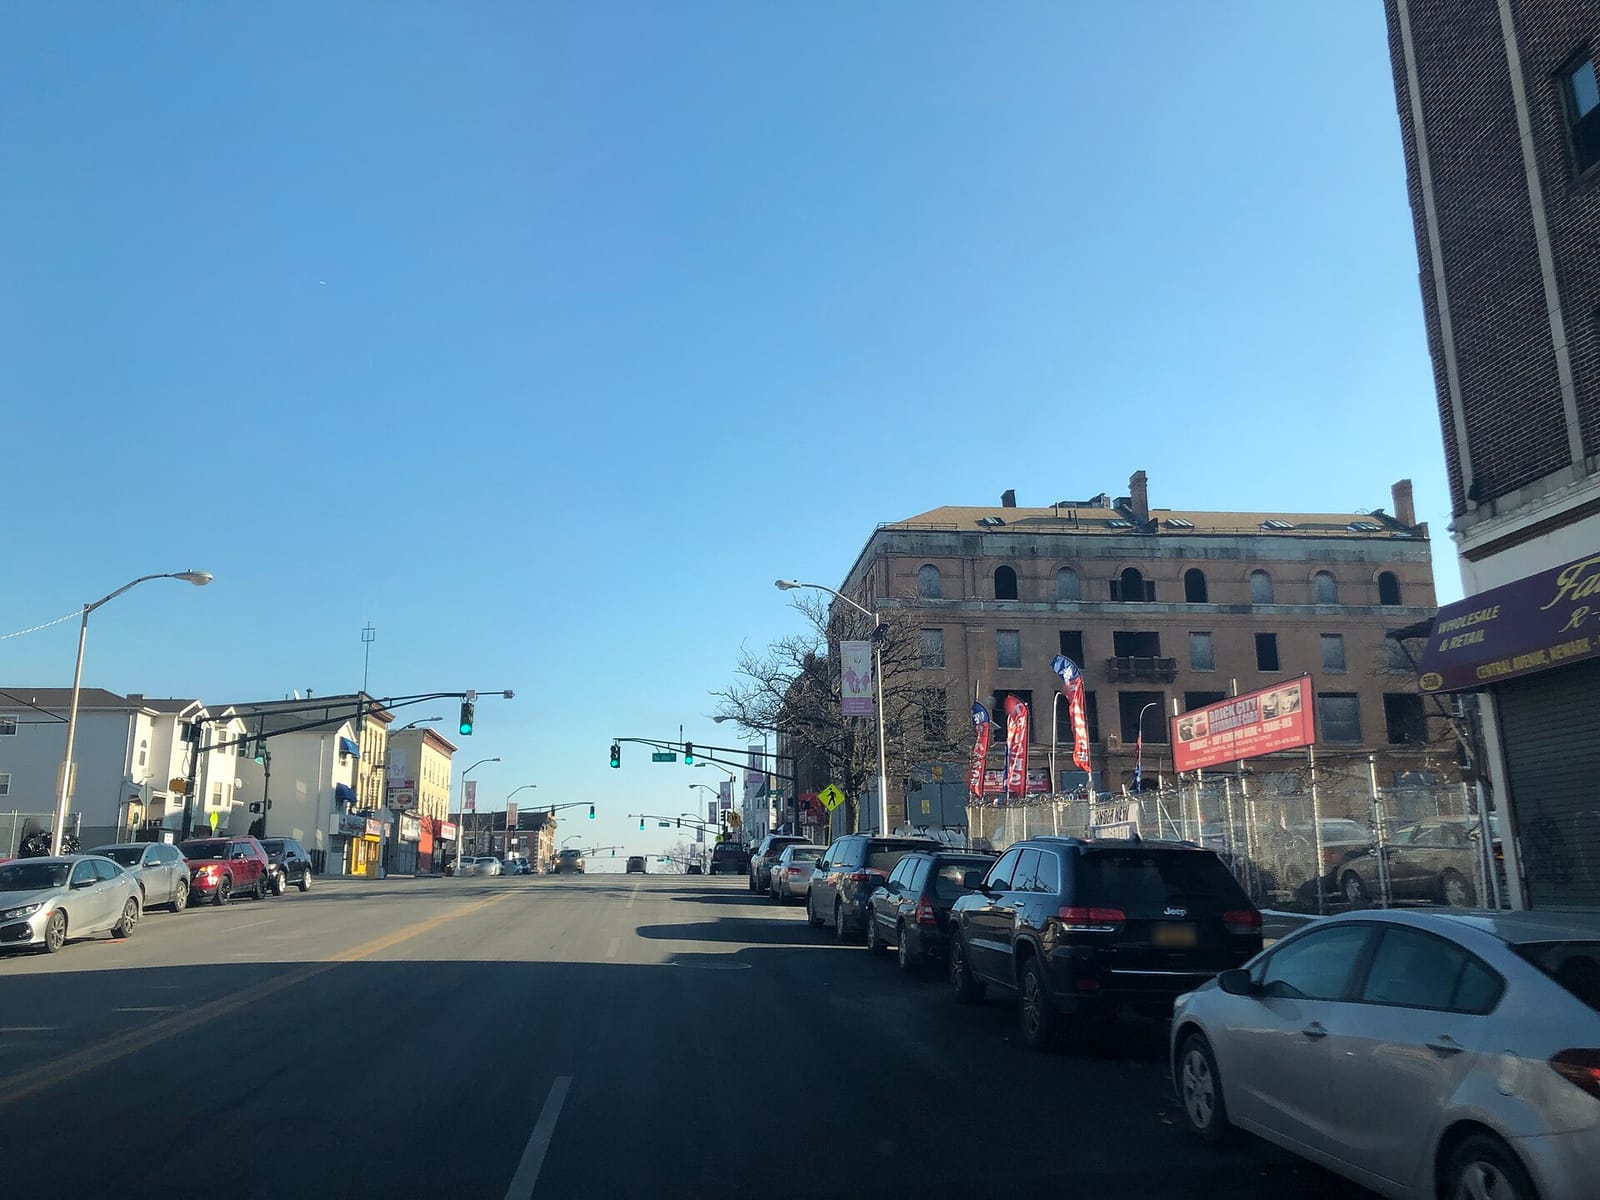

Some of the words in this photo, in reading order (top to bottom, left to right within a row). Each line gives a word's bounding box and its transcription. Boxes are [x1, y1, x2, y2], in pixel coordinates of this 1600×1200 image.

[1438, 605, 1501, 634] WHOLESALE
[1449, 629, 1485, 649] RETAIL
[1476, 659, 1513, 680] CENTRAL
[1549, 637, 1592, 661] NEWARK
[1208, 703, 1236, 723] BRICK
[1236, 696, 1257, 715] CITY
[1163, 906, 1188, 917] Jeep
